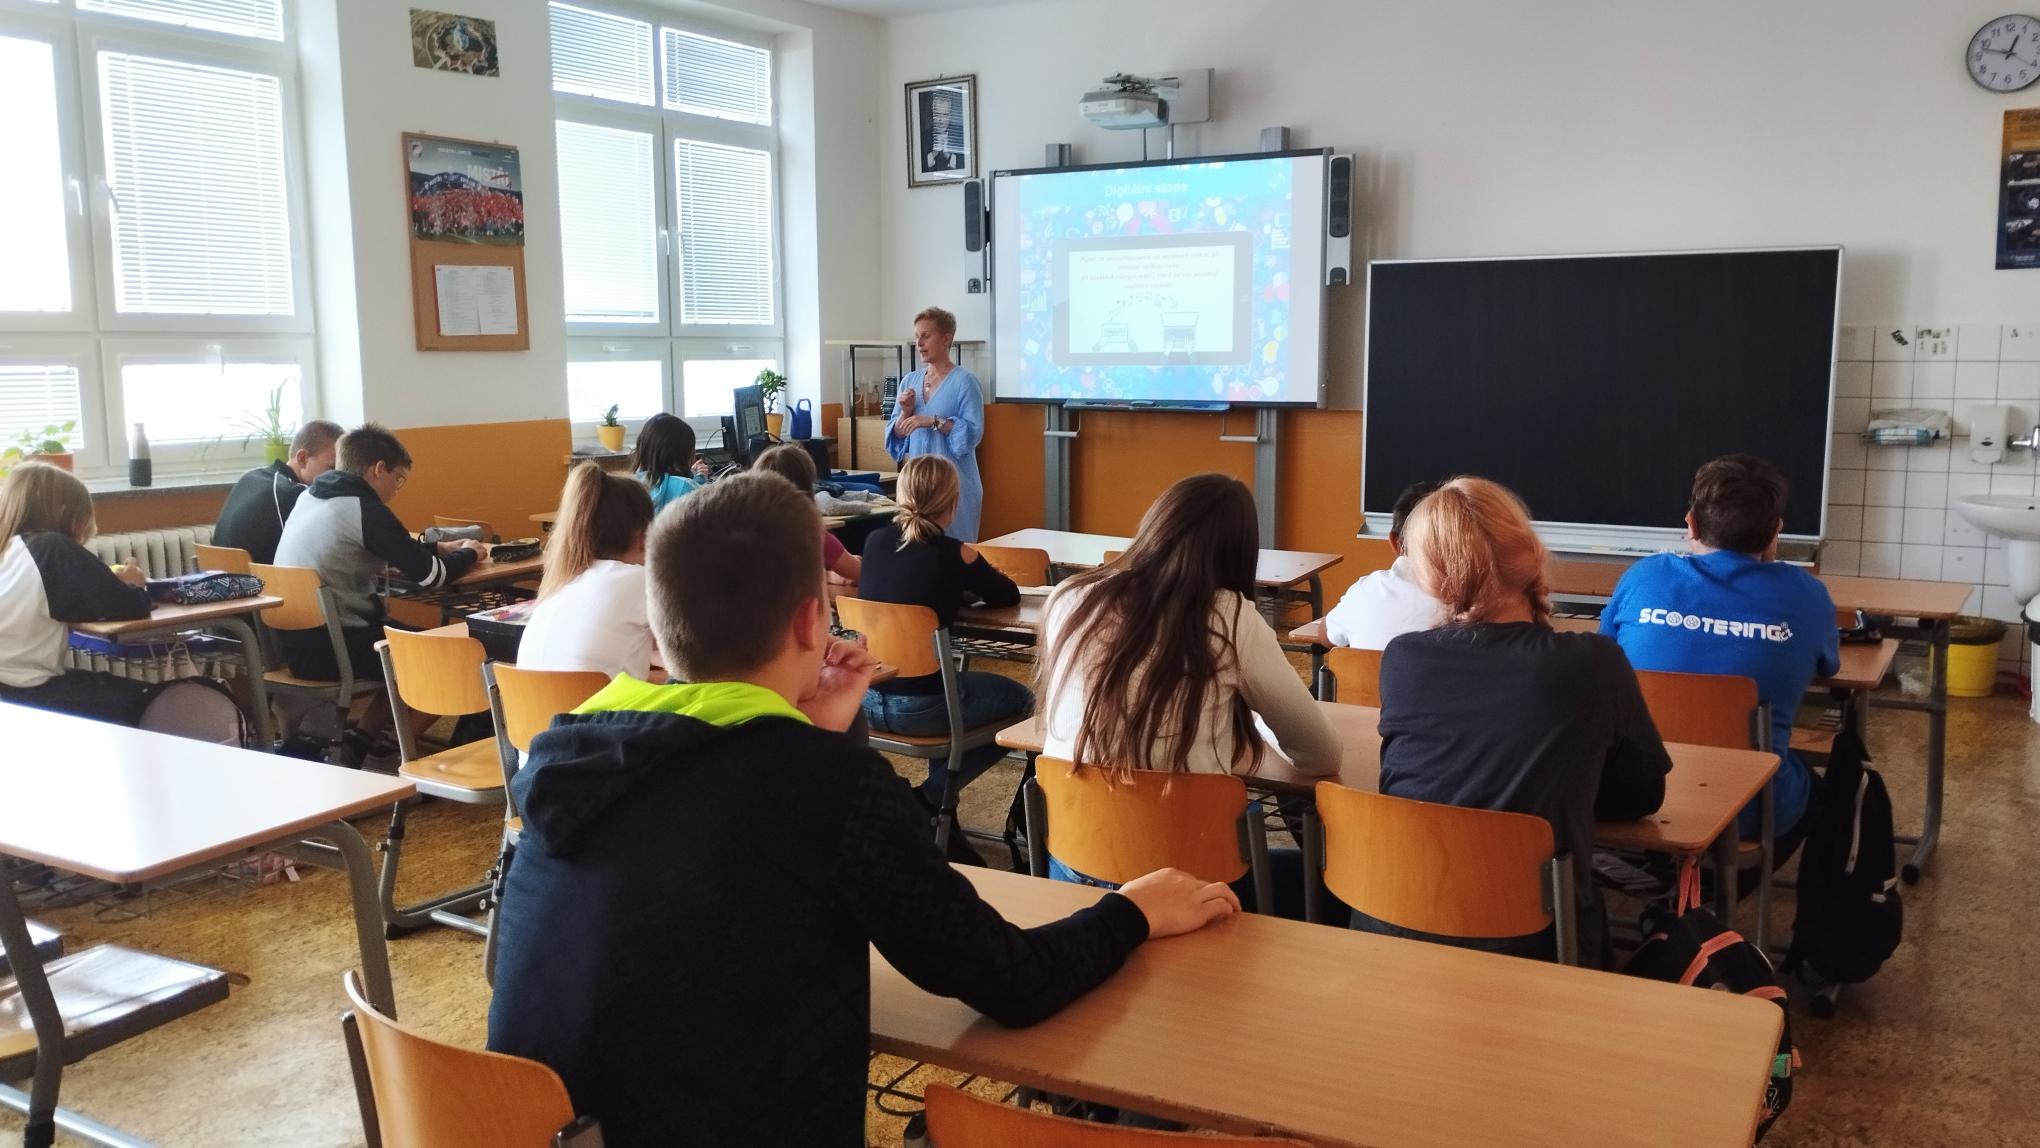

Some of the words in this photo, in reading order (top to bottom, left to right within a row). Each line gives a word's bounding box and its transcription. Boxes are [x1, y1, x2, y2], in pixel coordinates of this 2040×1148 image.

[2006, 23, 2016, 32] 12
[2023, 24, 2027, 34] 1
[1992, 29, 2000, 38] 11
[2033, 33, 2039, 42] 2
[1982, 40, 1991, 50] 10
[1976, 52, 1983, 61] 9
[1980, 65, 1987, 74] 8
[1992, 73, 1998, 81] 7
[2020, 70, 2027, 79] 5
[2005, 75, 2012, 84] 6
